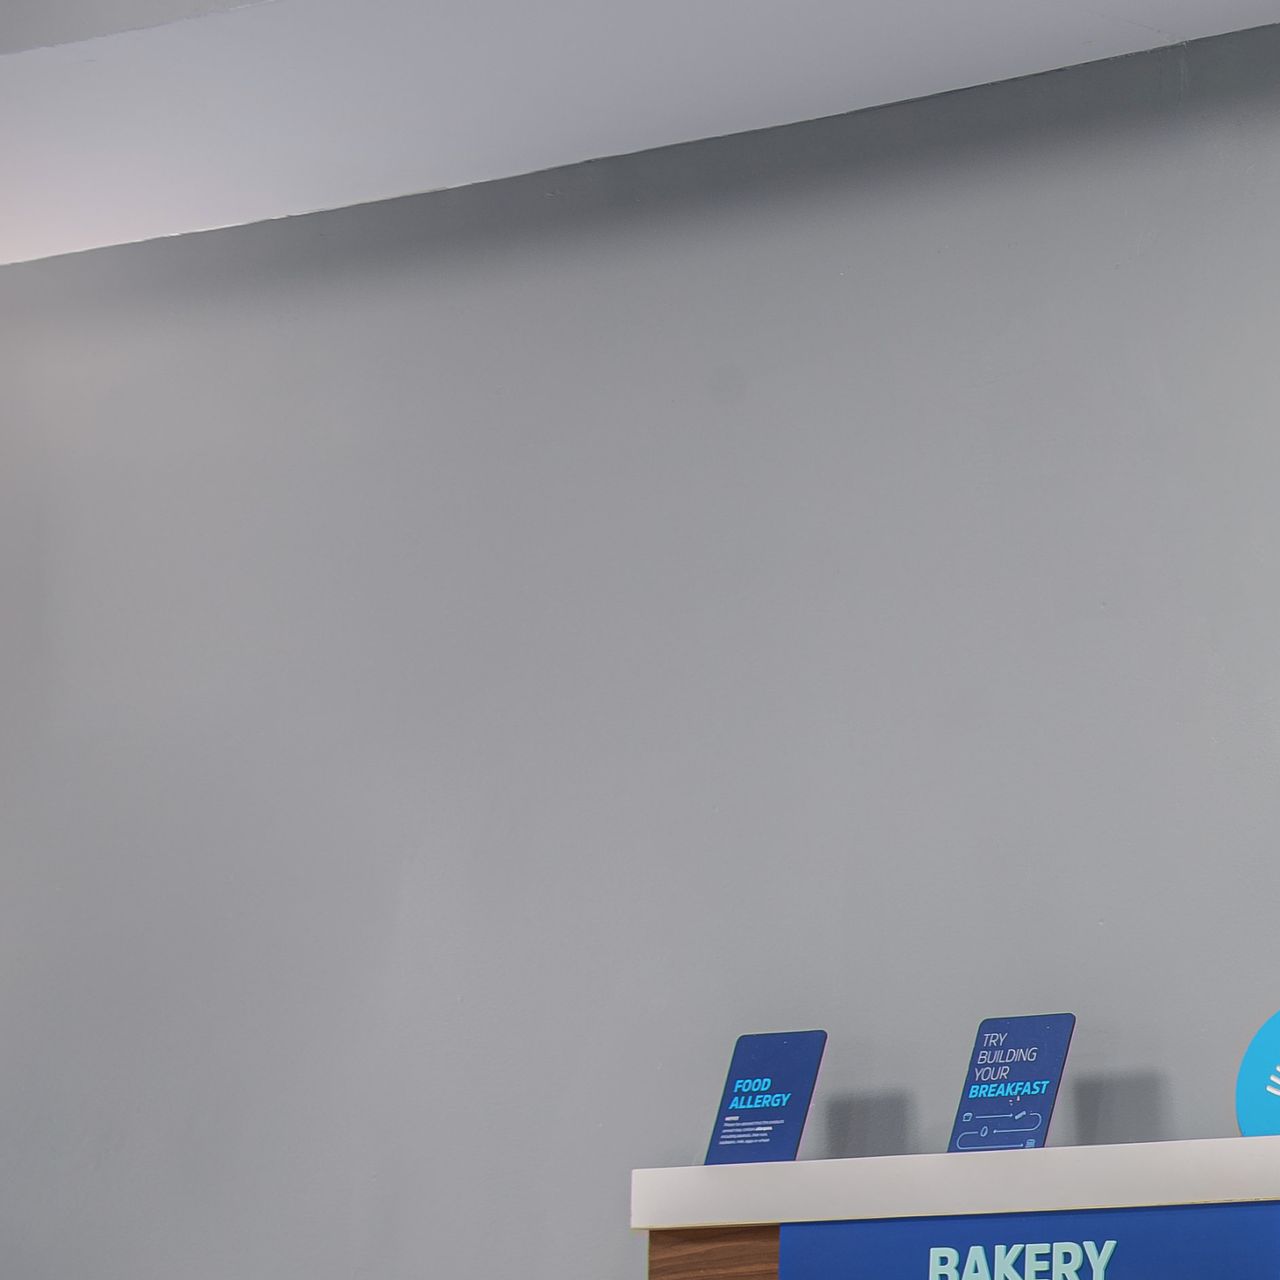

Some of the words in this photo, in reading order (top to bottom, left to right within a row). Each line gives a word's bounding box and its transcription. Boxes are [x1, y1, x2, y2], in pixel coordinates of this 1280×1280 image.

[983, 1033, 1008, 1047] TRY
[977, 1047, 1038, 1065] BUILDING
[974, 1066, 1010, 1082] YOUR
[733, 1078, 771, 1093] FOOD
[968, 1080, 1050, 1099] BREAKFAST
[728, 1093, 792, 1110] ALLERGY
